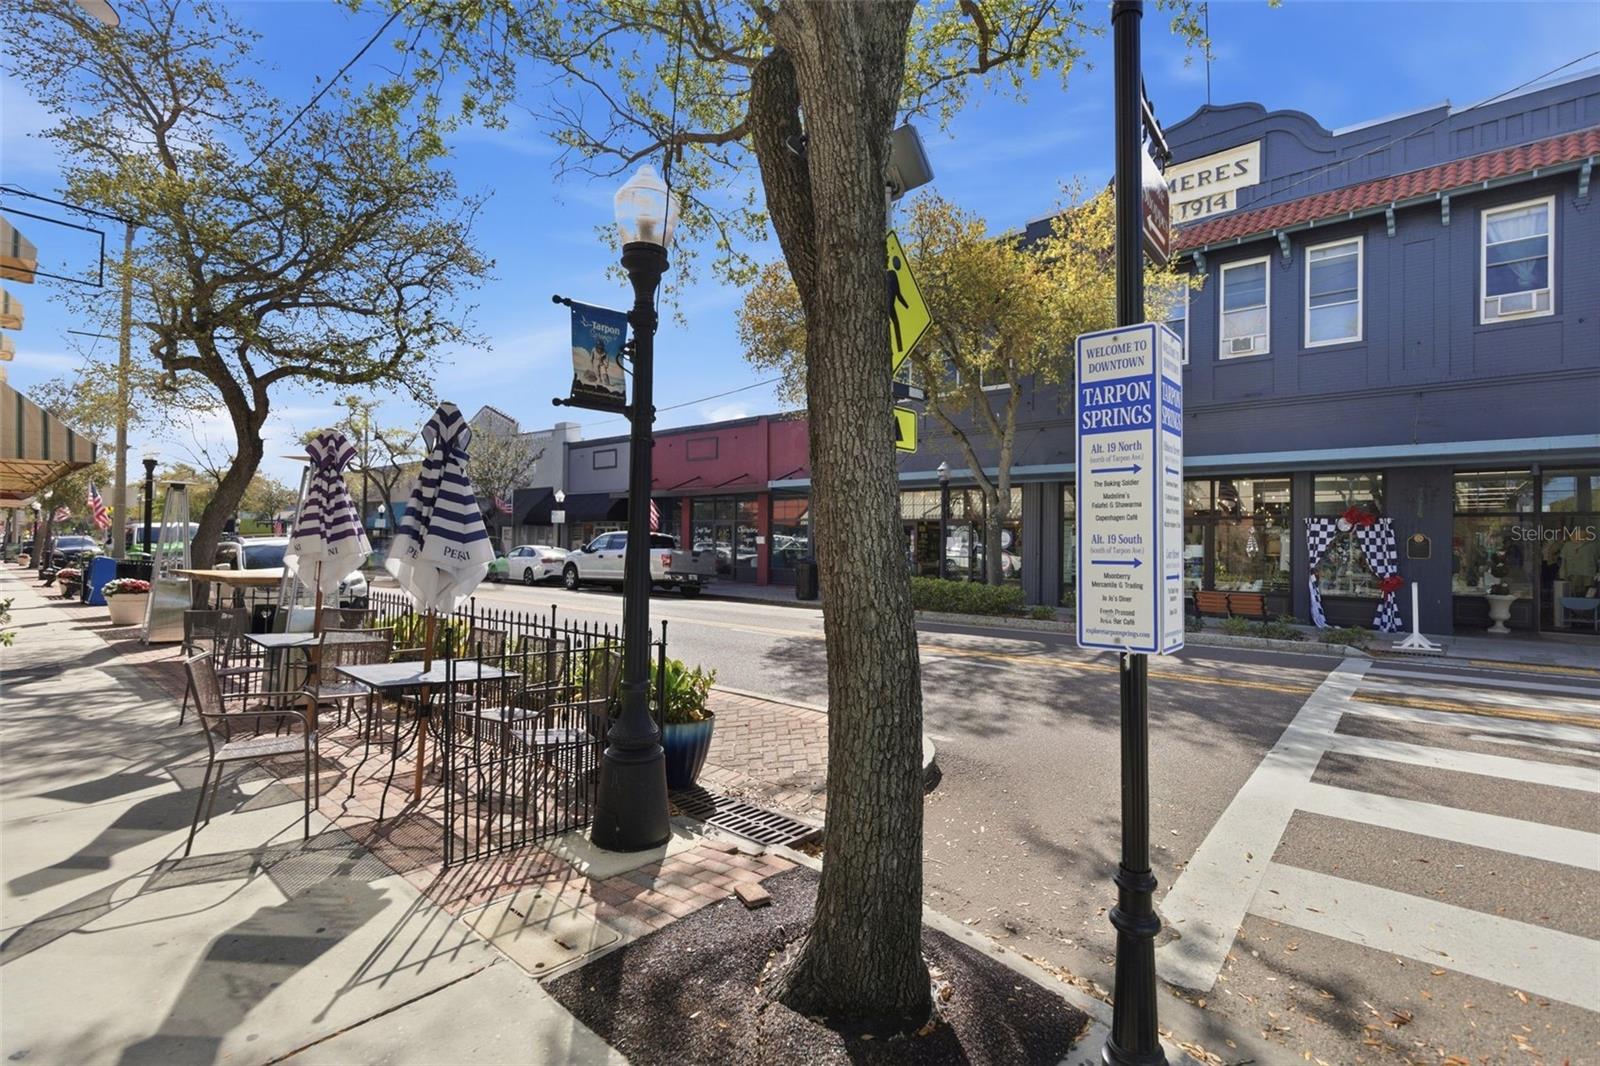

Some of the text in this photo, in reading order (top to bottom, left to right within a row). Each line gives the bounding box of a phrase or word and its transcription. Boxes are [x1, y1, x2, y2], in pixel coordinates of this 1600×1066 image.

[1179, 193, 1228, 219] 1914
[592, 321, 620, 336] Tarpon
[1086, 342, 1132, 359] WELCOME
[1134, 339, 1147, 352] TO
[1088, 356, 1145, 374] DOWNTOWN
[1082, 380, 1152, 407] TARPON
[1082, 404, 1152, 430] SPRINGS
[1091, 440, 1143, 454] Alt. 19 North
[1095, 514, 1125, 522] Copenhagen
[1091, 533, 1143, 544] Alt. 19 South
[1124, 582, 1144, 590] Trading
